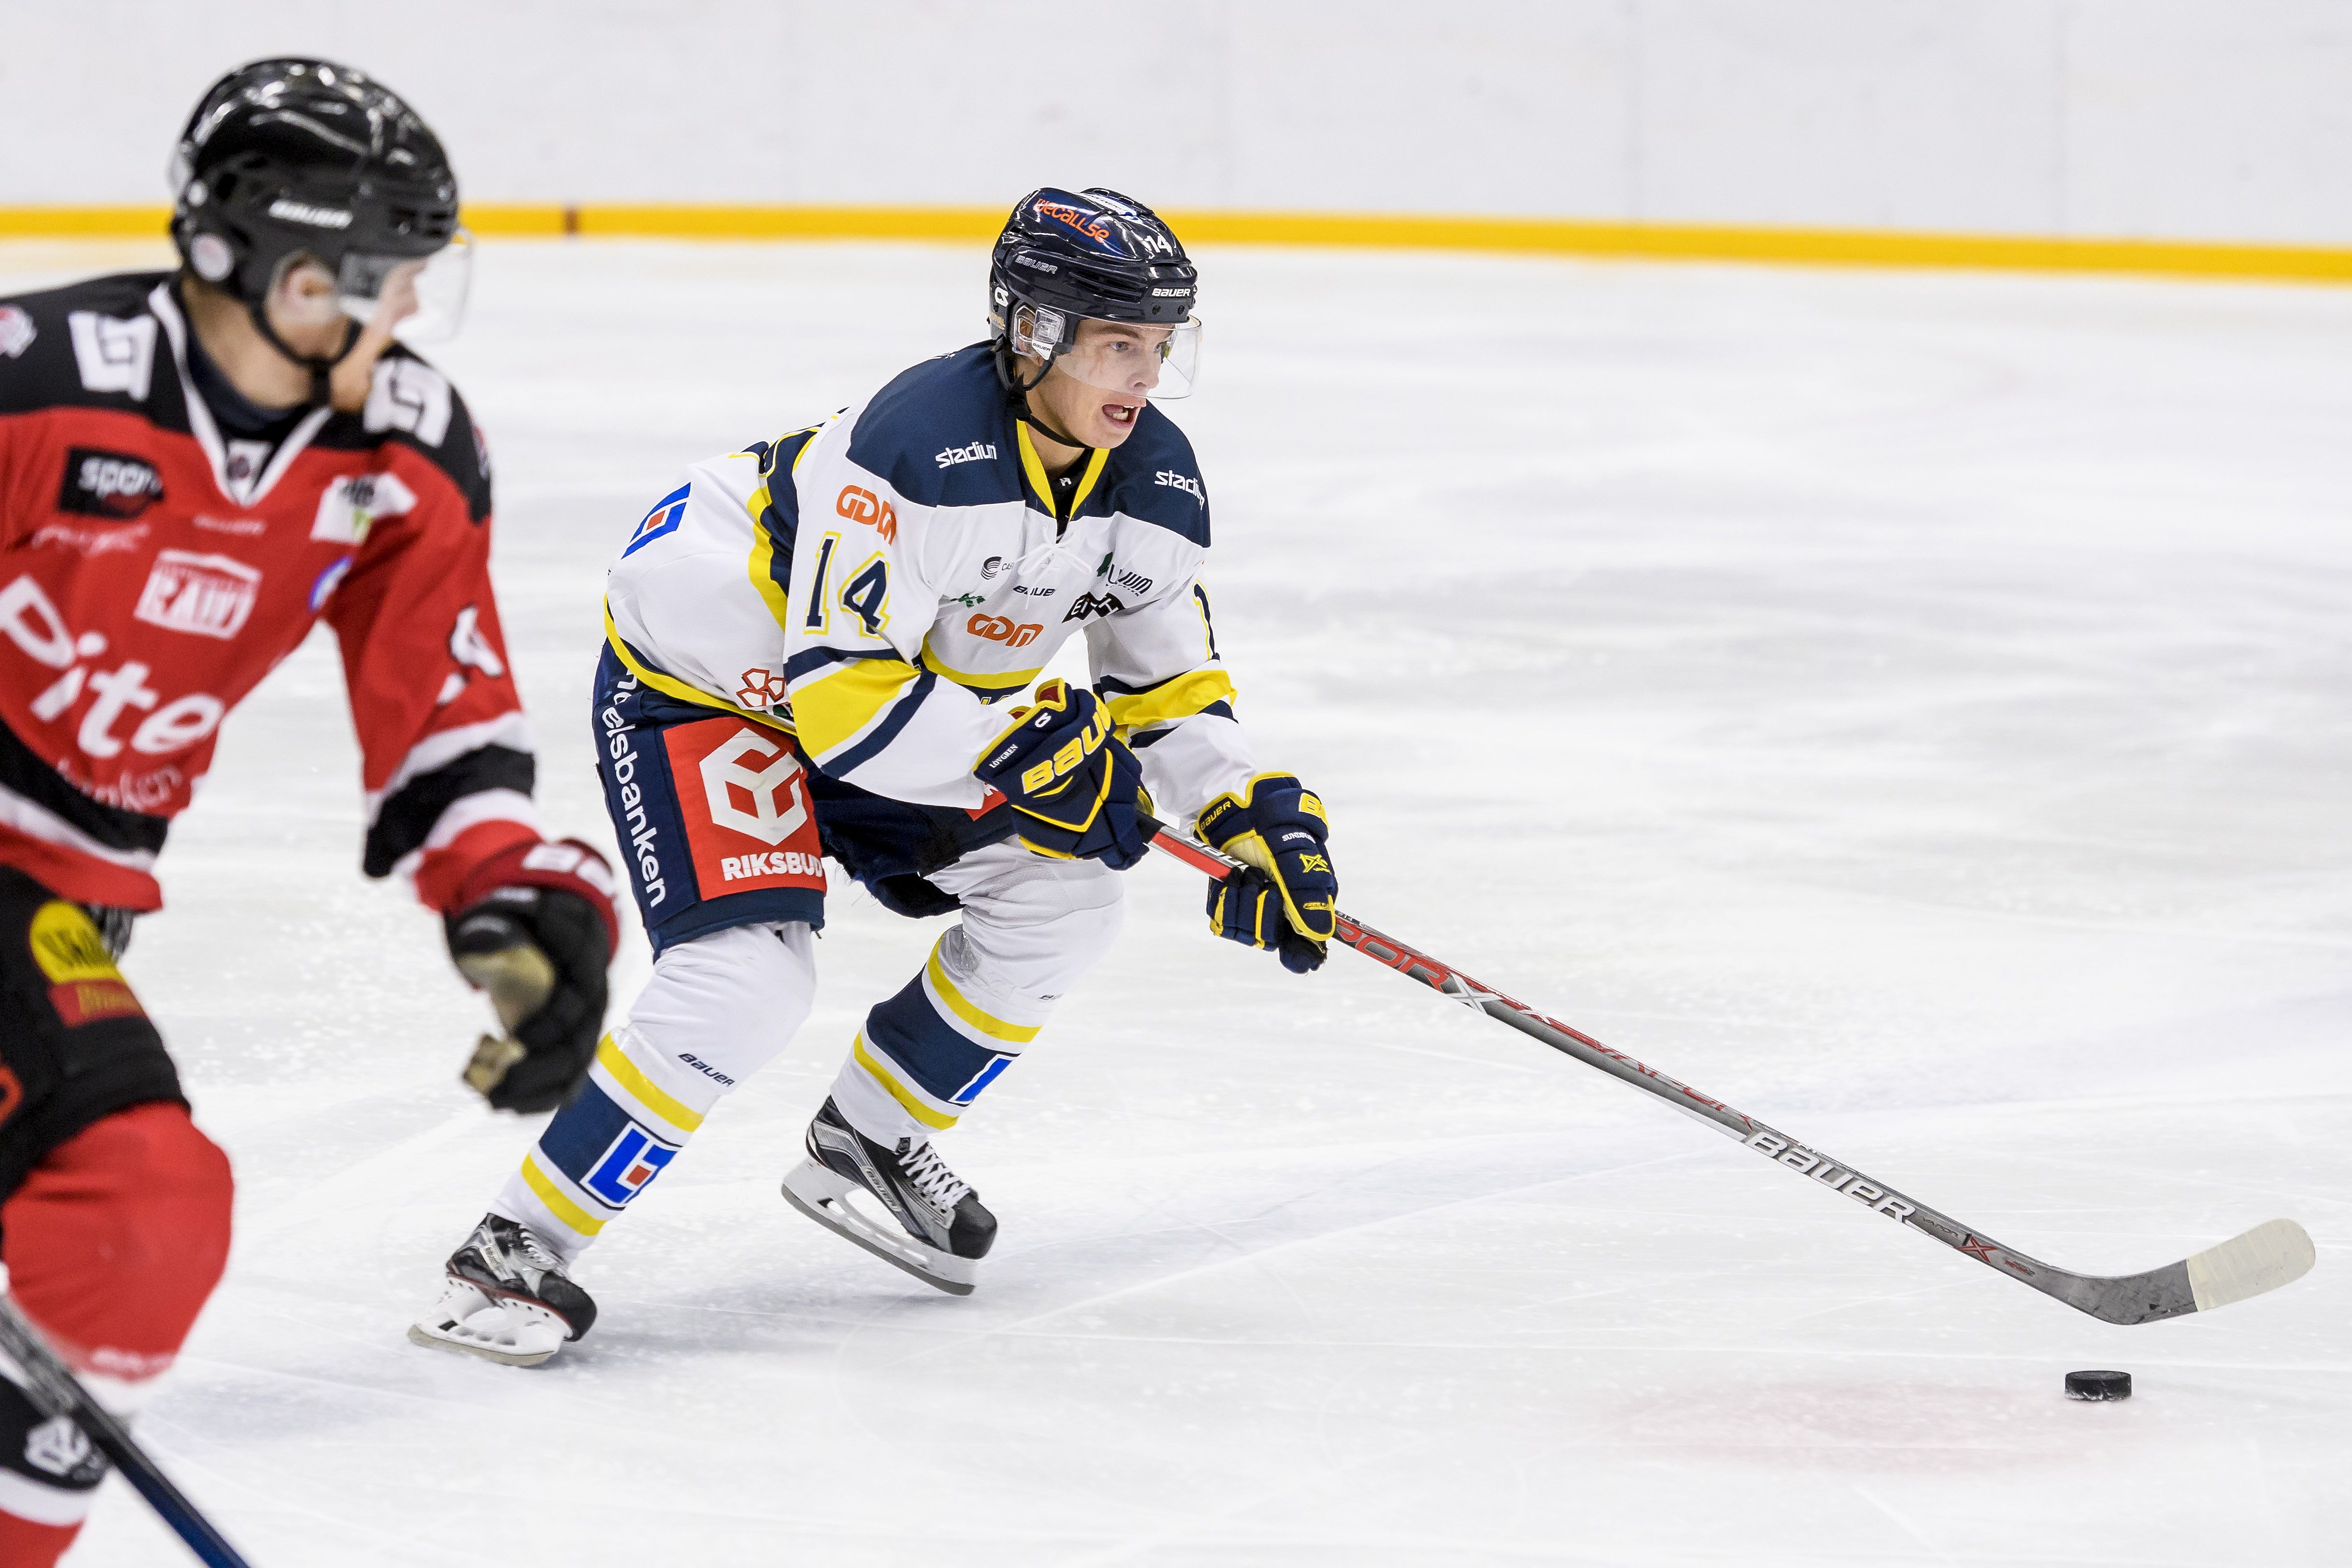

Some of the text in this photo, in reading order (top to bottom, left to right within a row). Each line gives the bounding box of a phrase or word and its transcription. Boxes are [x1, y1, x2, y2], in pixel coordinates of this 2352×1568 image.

[1145, 235, 1173, 257] 14
[1015, 255, 1058, 274] BAUER
[1151, 288, 1191, 297] BAUER
[1032, 342, 1051, 351] BAUER
[804, 530, 891, 640] 14
[1012, 585, 1056, 597] BUE
[1200, 801, 1231, 831] BAUER
[677, 1053, 735, 1087] BAUER
[1745, 1131, 1916, 1223] BAUER
